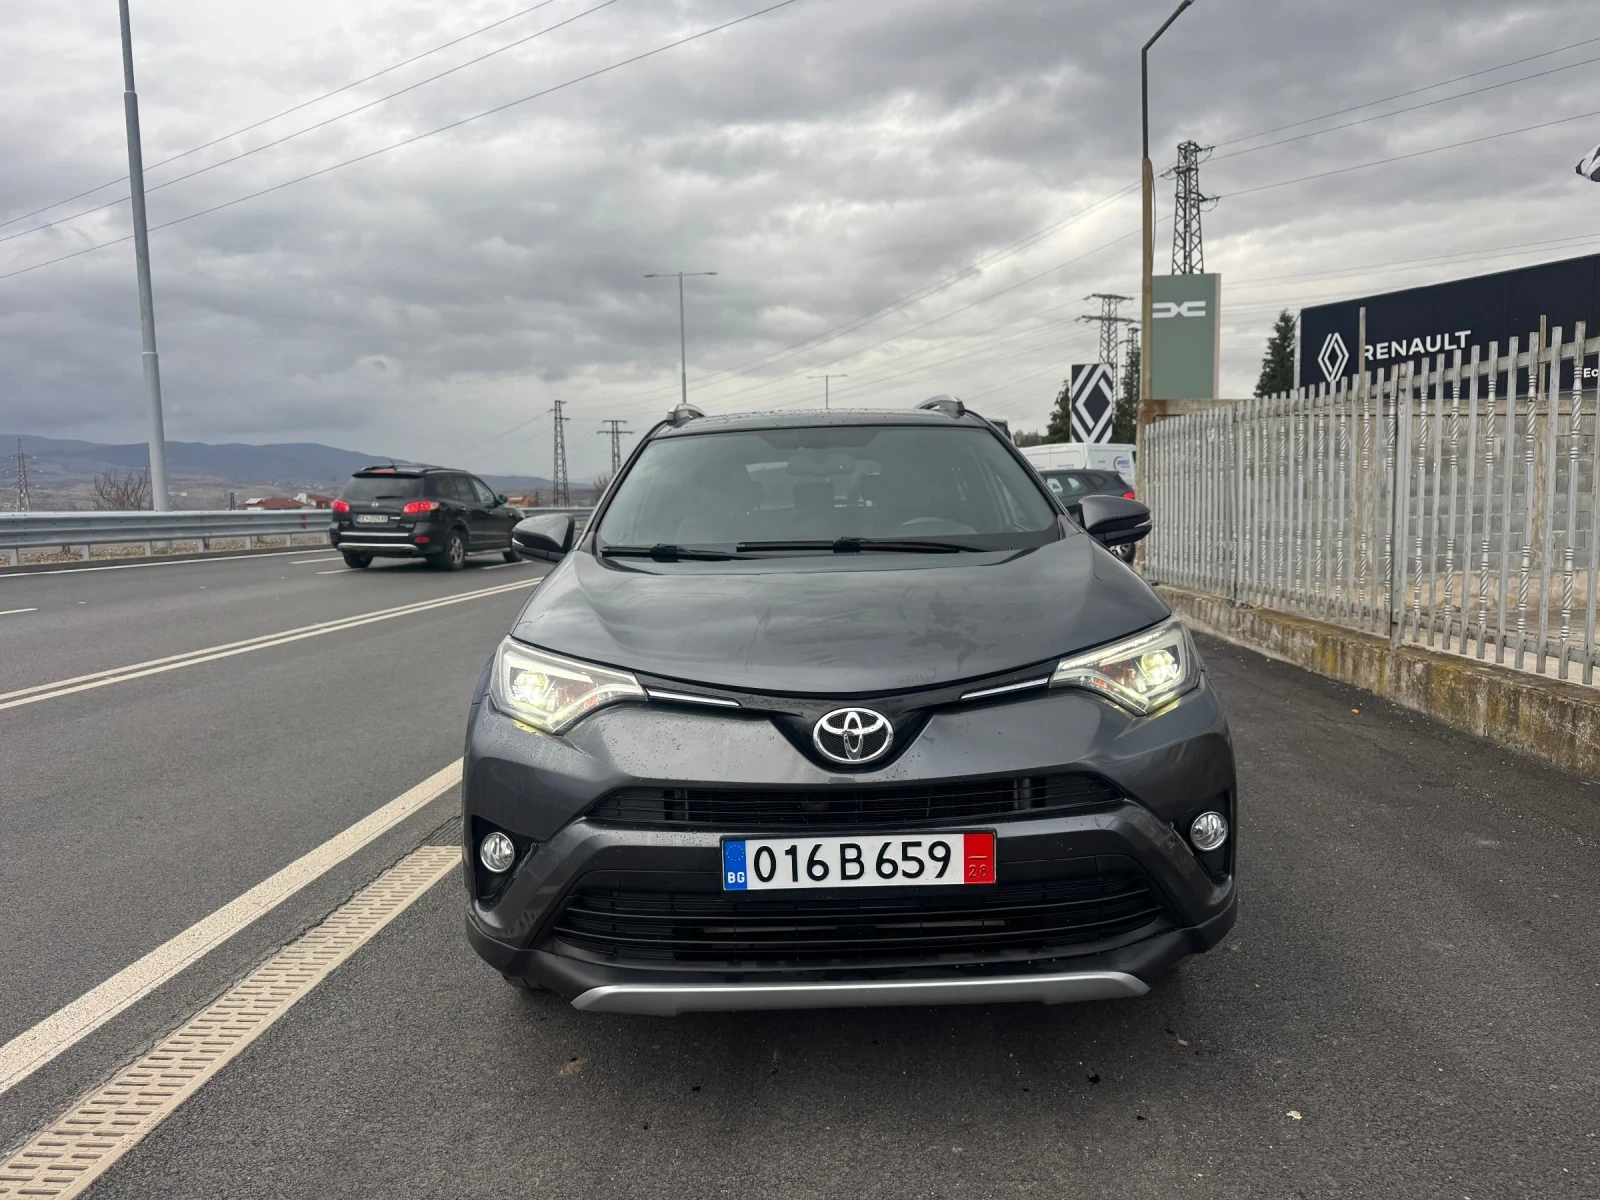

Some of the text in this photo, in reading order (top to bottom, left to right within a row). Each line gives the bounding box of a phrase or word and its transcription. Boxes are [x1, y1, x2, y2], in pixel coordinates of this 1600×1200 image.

[1364, 330, 1471, 360] RENAULT
[727, 840, 988, 884] BG 016 B 659 28
